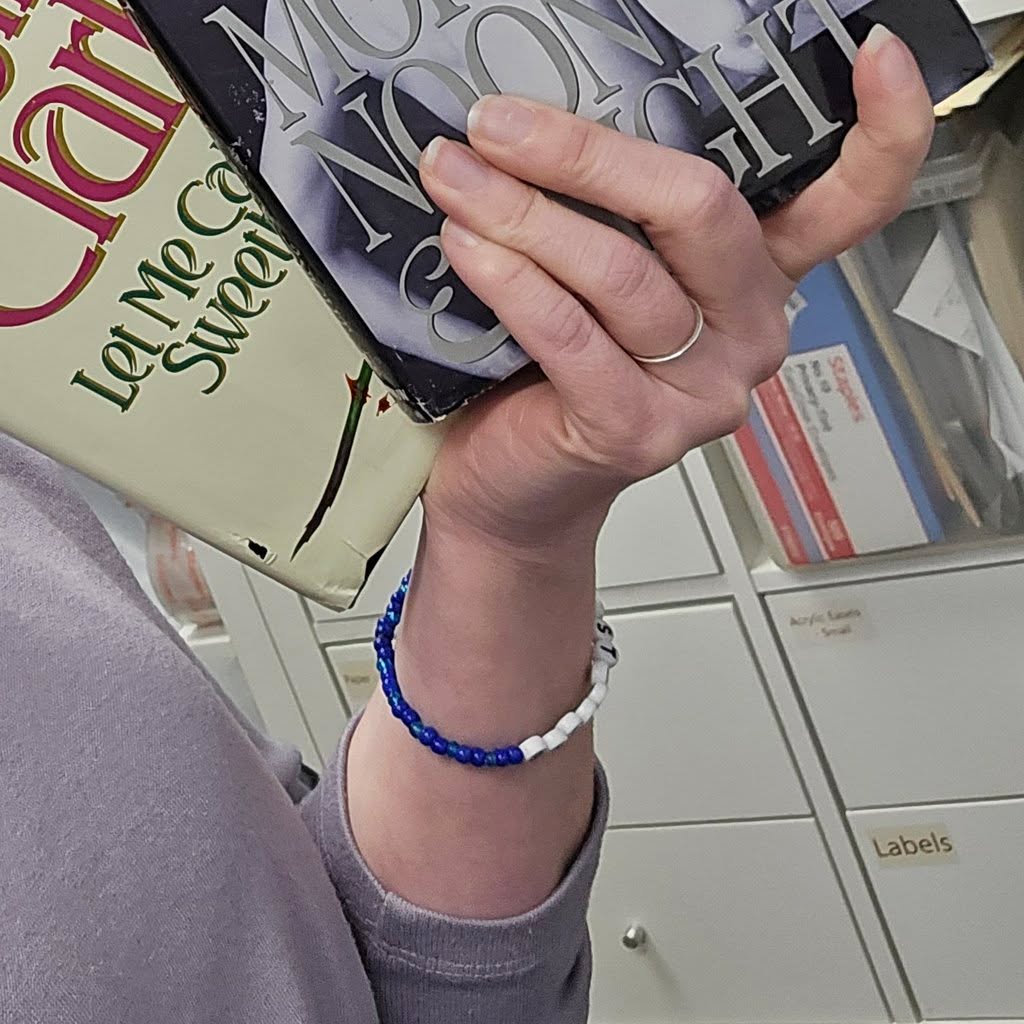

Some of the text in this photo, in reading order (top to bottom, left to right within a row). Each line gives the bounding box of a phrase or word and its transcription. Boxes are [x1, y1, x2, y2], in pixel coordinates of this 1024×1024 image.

[70, 142, 253, 413] Let Me Ca
[161, 211, 294, 395] Sweet
[872, 831, 954, 859] Labels
